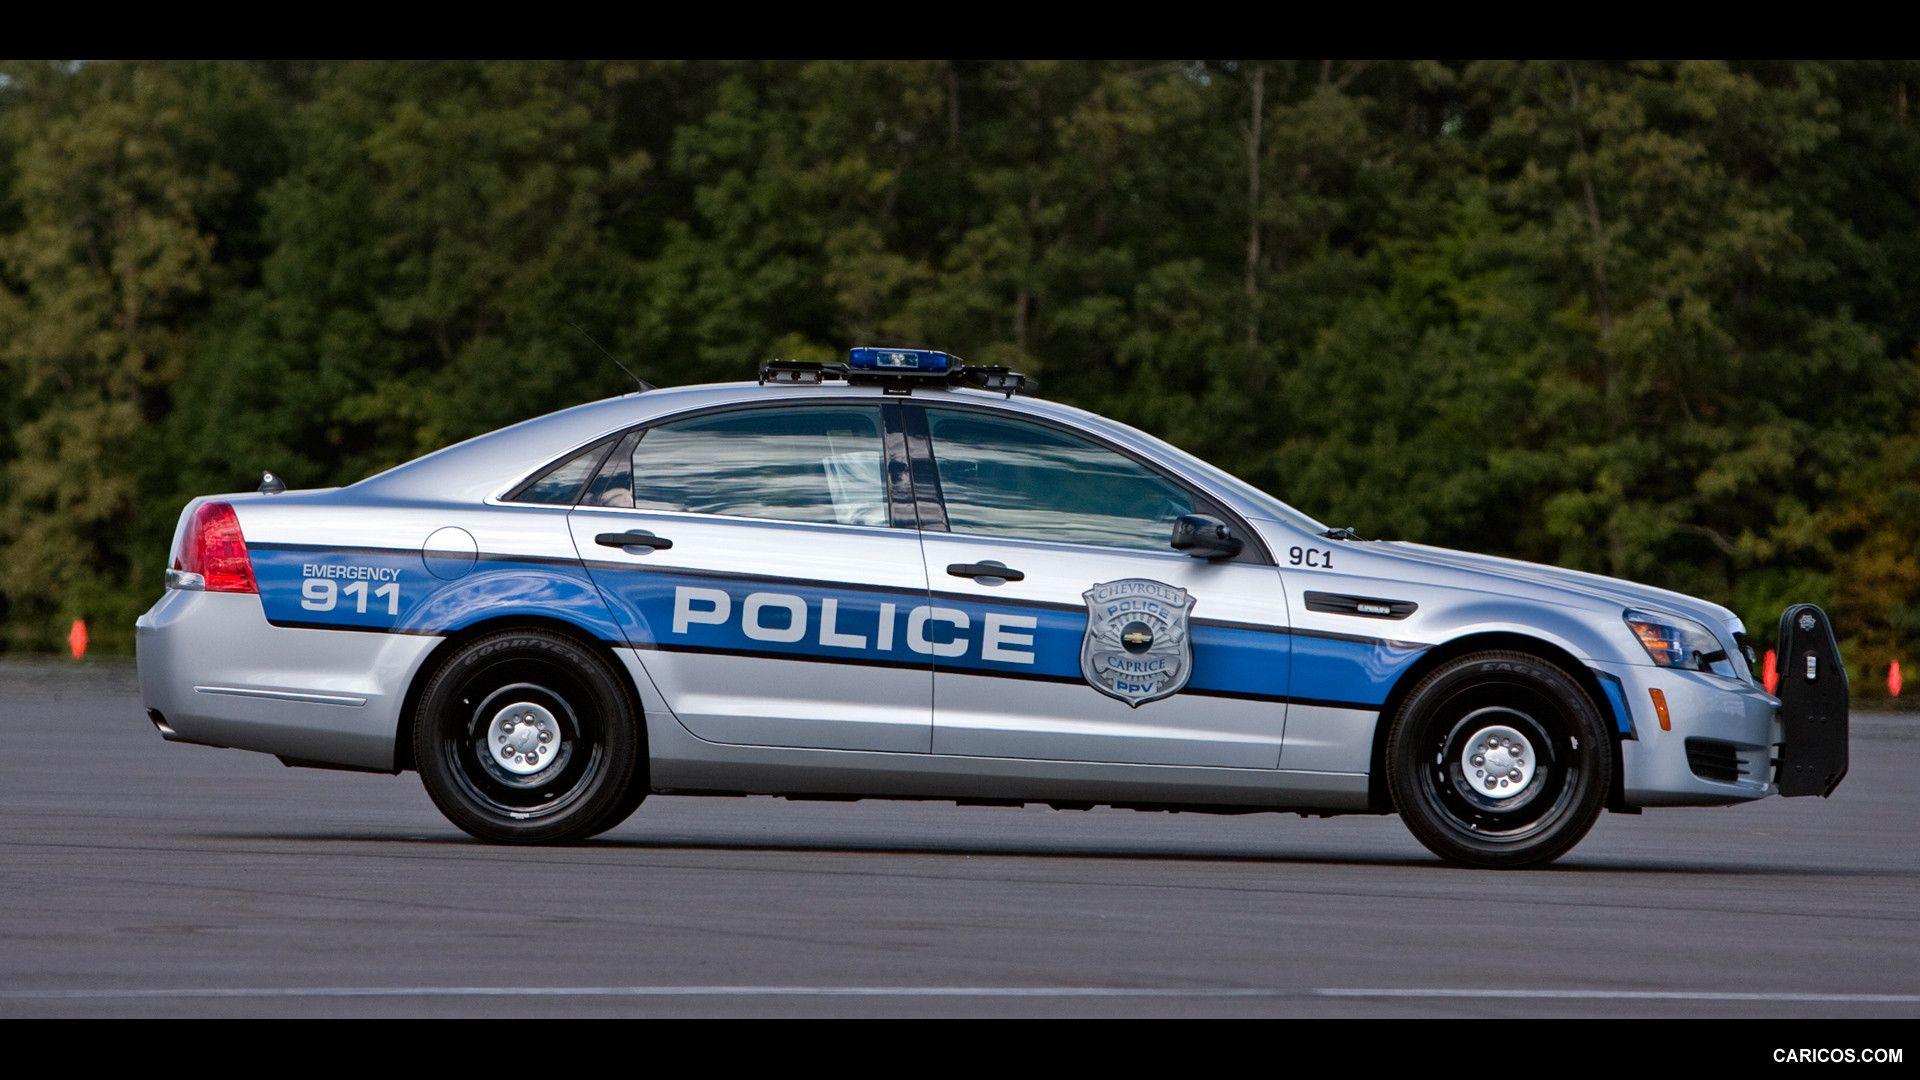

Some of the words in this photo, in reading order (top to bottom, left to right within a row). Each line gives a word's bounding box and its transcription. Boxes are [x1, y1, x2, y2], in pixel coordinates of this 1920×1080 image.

[1289, 546, 1334, 569] 9C1
[303, 564, 401, 581] EMERGENCY
[301, 578, 400, 615] 911
[1098, 583, 1182, 603] CHEVROLET
[1107, 600, 1170, 619] POLICE
[672, 587, 1037, 663] POLICE
[1107, 656, 1166, 673] CAPRICE
[1116, 681, 1154, 693] PPV
